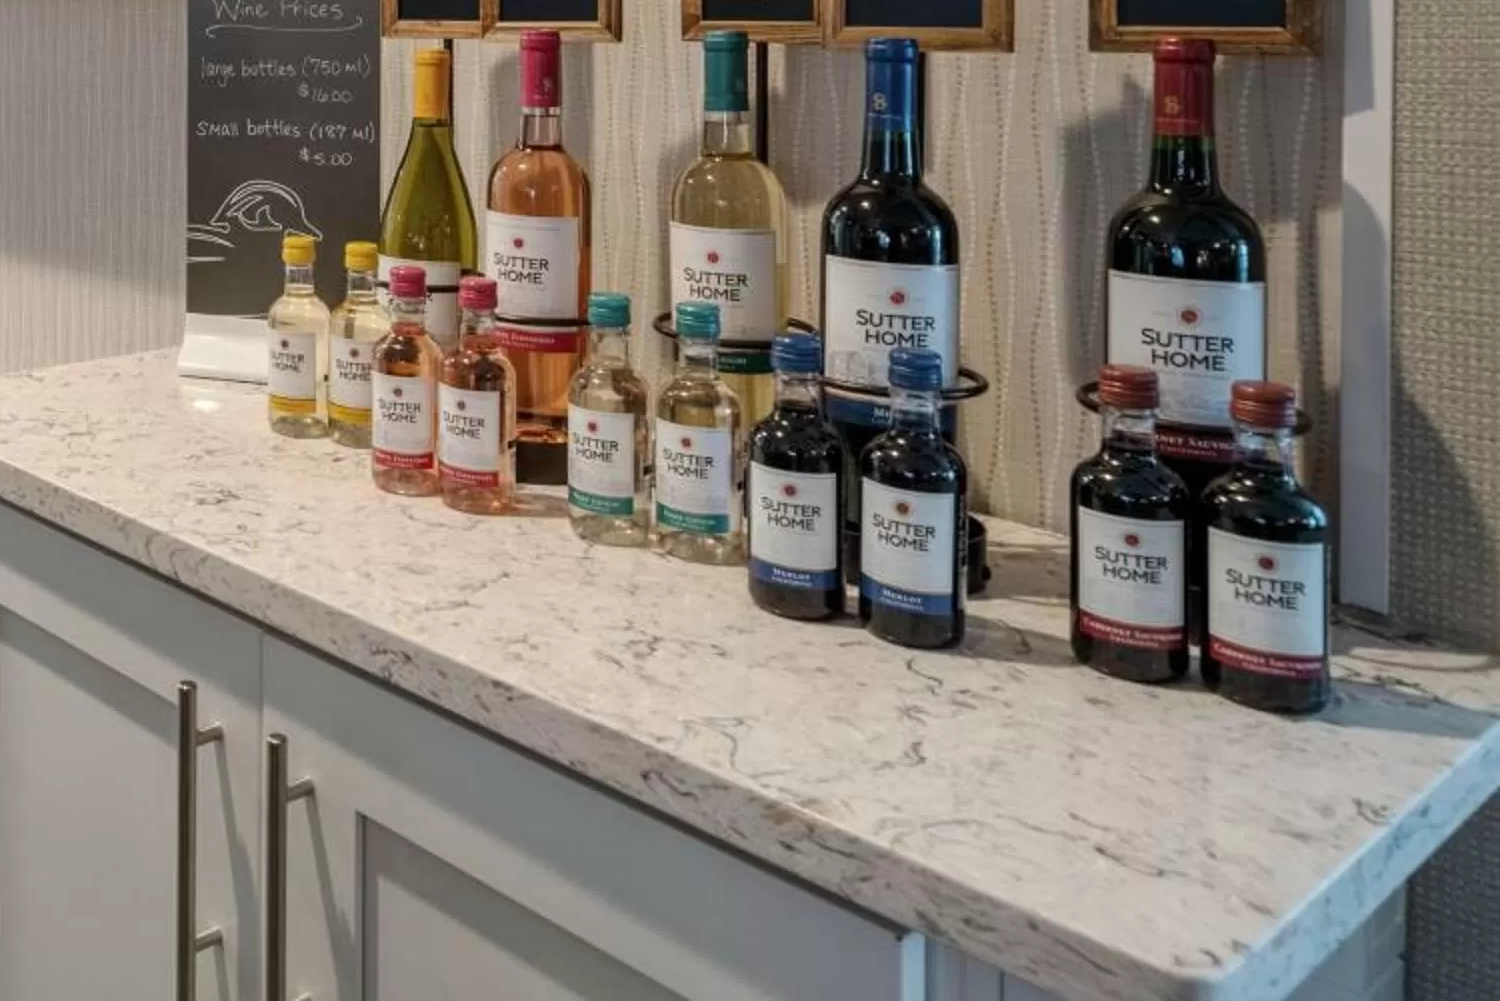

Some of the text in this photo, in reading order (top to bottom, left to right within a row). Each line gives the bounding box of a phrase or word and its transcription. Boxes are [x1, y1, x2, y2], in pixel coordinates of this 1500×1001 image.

[241, 58, 297, 77] bottles
[302, 55, 340, 77] (750
[246, 118, 300, 137] bottles
[309, 122, 346, 141] (187
[494, 252, 549, 271] SUTTER
[497, 270, 545, 284] HOME
[683, 267, 748, 287] SUTTER
[689, 285, 741, 302] HOME
[856, 309, 936, 330] SUTTER
[865, 329, 928, 348] HOME
[1141, 327, 1234, 353] SUTTER
[1151, 349, 1226, 372] HOME
[379, 399, 421, 413] SUTTER
[382, 412, 418, 423] HOME
[443, 410, 485, 428] SUTTER
[446, 425, 481, 439] HOME
[572, 432, 619, 451] SUTTER
[575, 449, 613, 463] HOME
[663, 448, 714, 467] SUTTER
[667, 464, 708, 479] HOME
[761, 496, 821, 518] SUTTER
[767, 515, 815, 532] HOME
[872, 513, 936, 539] SUTTER
[877, 531, 929, 552] HOME
[1095, 546, 1167, 571] SUTTER
[1103, 565, 1160, 585] HOME
[1225, 568, 1306, 596] SUTTER
[1235, 588, 1297, 610] HOME
